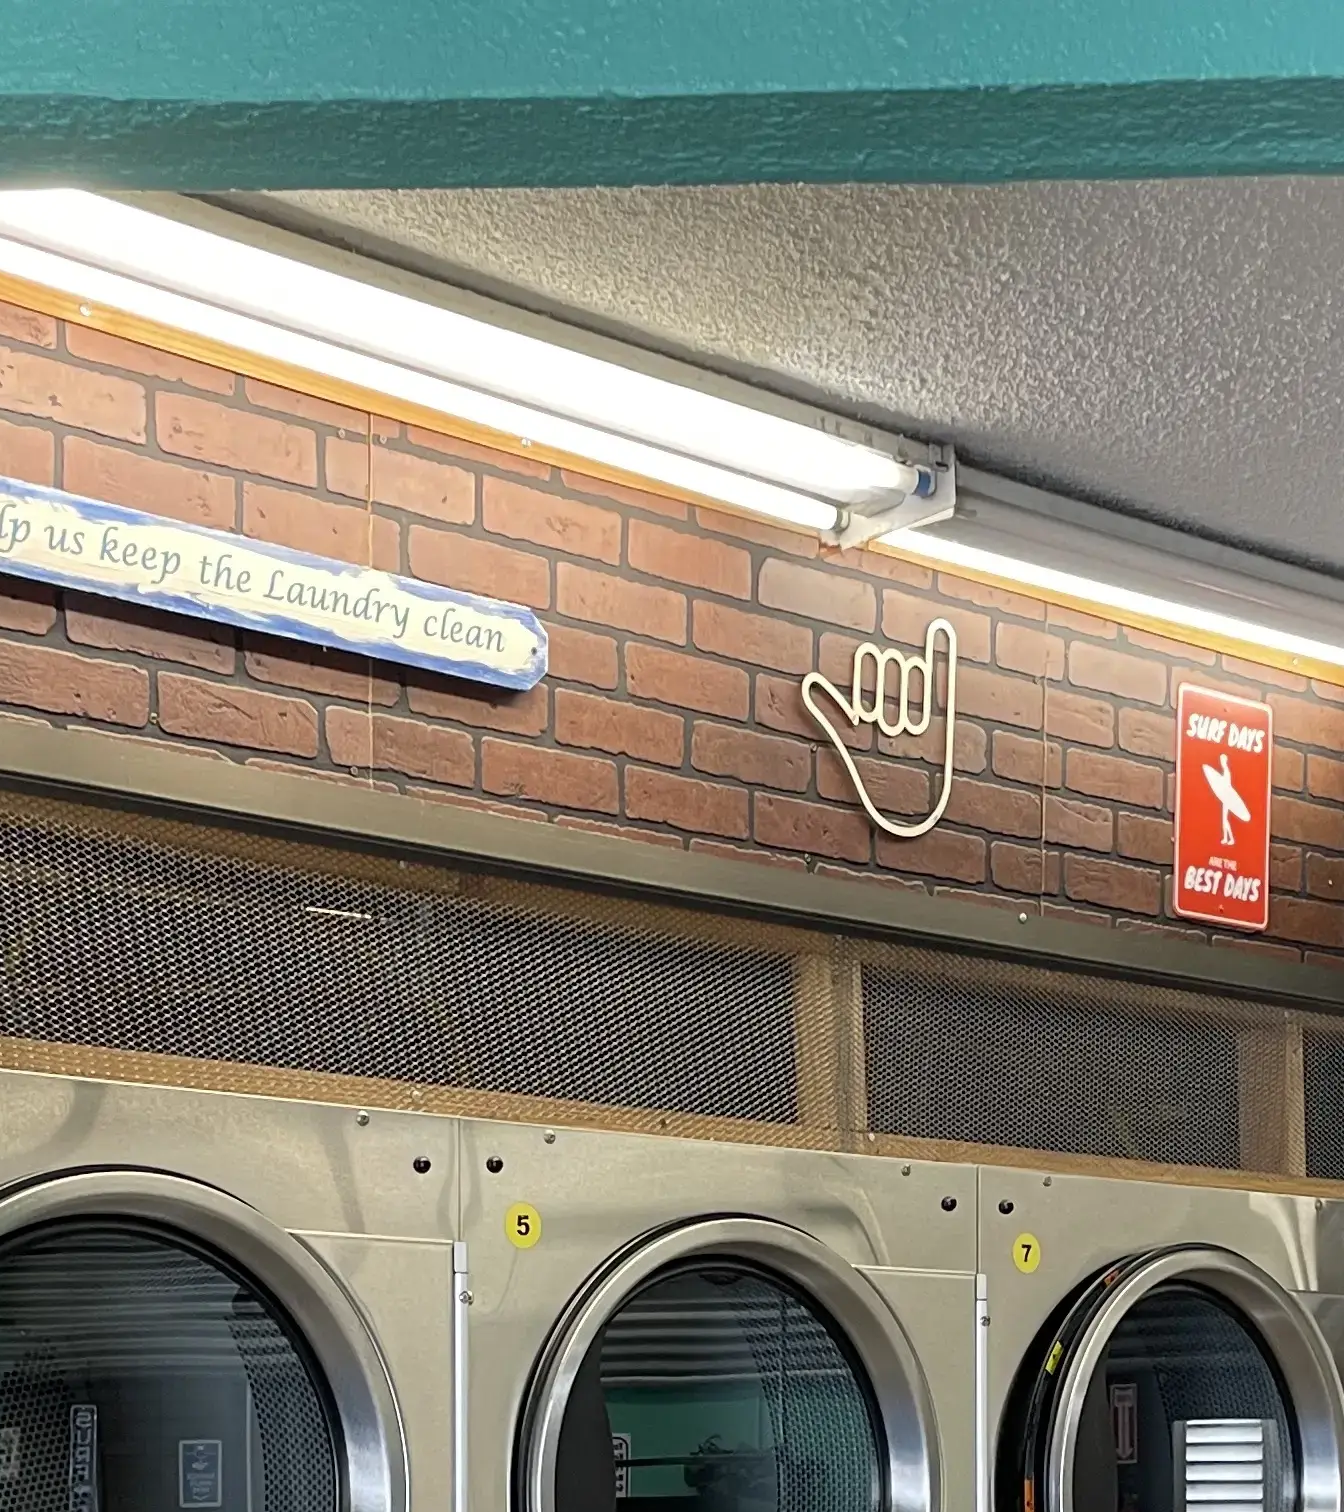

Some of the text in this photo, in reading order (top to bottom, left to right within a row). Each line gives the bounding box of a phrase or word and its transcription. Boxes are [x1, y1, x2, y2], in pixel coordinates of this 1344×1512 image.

[44, 523, 86, 556] us
[99, 526, 182, 584] keep
[199, 553, 252, 593] the
[262, 570, 409, 637] Laundry
[423, 608, 505, 653] clean
[1187, 713, 1265, 754] SURF DAYS
[1184, 867, 1260, 902] BEST DAYS
[517, 1215, 530, 1236] 5
[1021, 1244, 1032, 1262] 7
